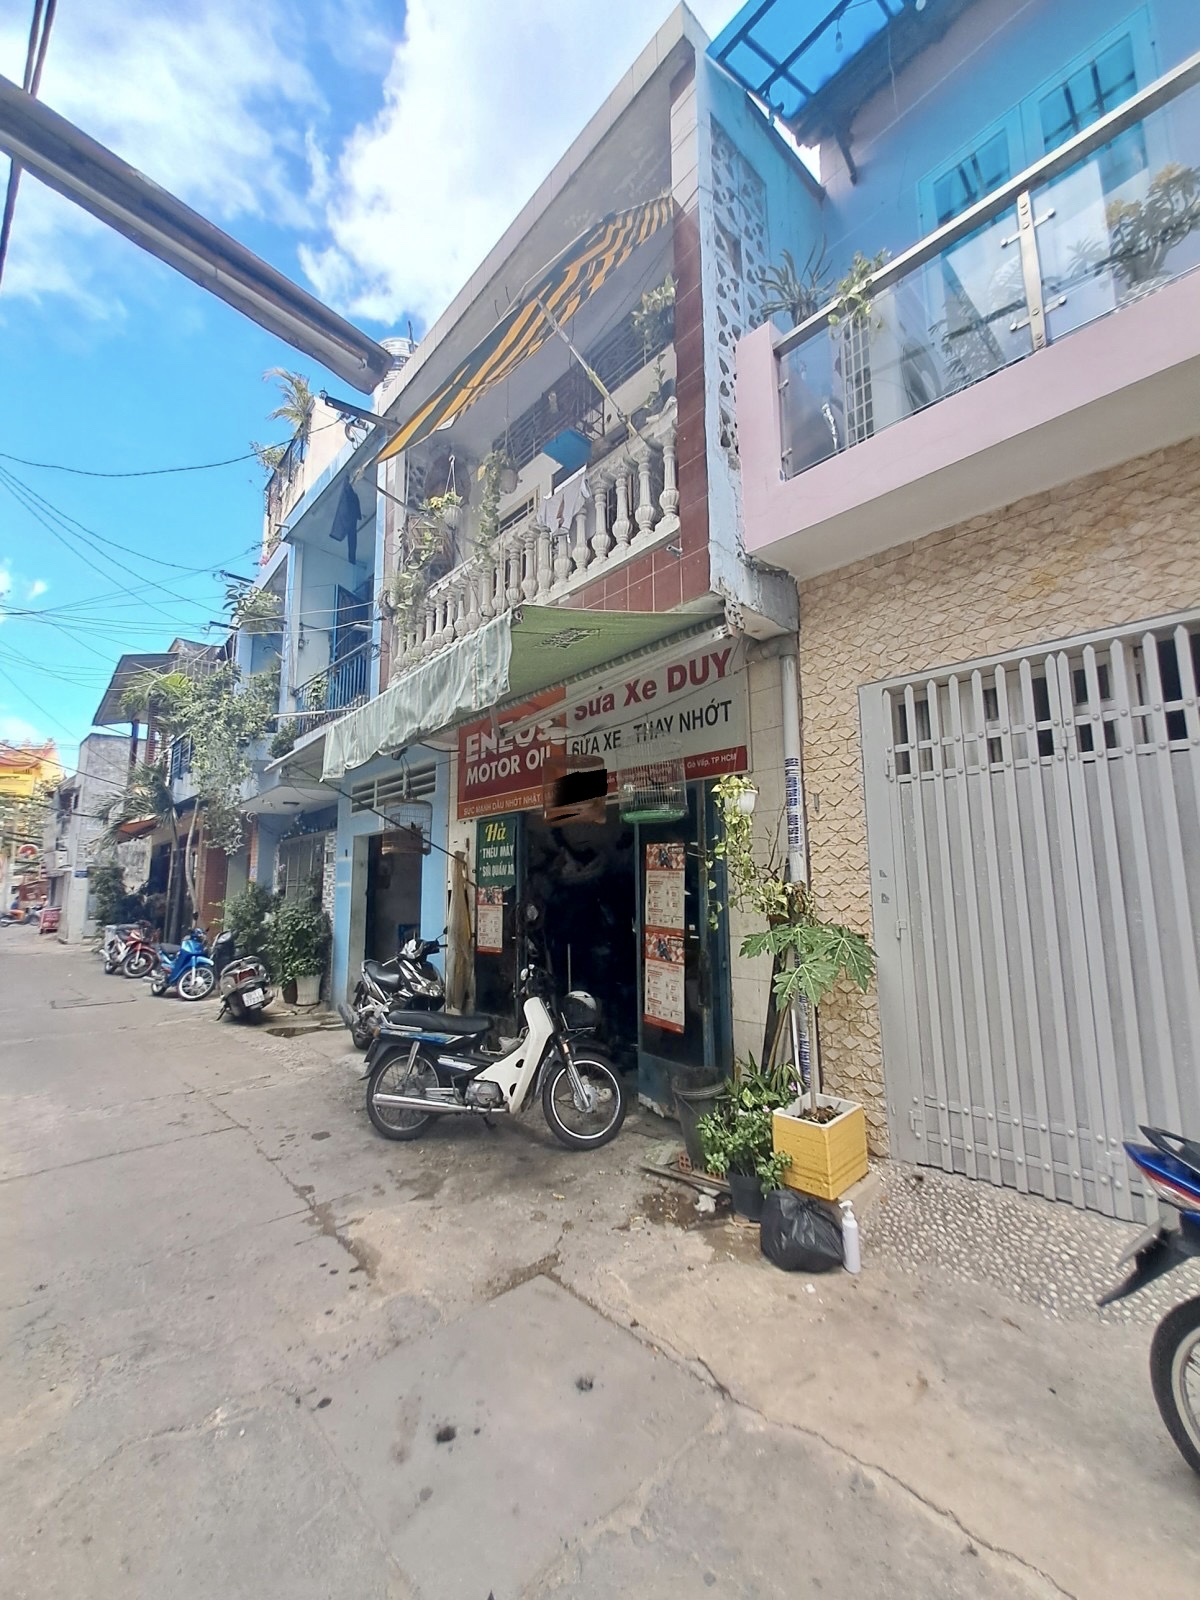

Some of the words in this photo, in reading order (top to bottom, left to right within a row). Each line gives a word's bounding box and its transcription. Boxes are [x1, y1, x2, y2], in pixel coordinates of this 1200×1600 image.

[624, 678, 657, 707] Xe
[667, 647, 732, 693] DUY
[604, 730, 622, 751] XE
[679, 698, 732, 733] NHỚT
[466, 754, 521, 786] MOTOR
[711, 755, 720, 764] TP
